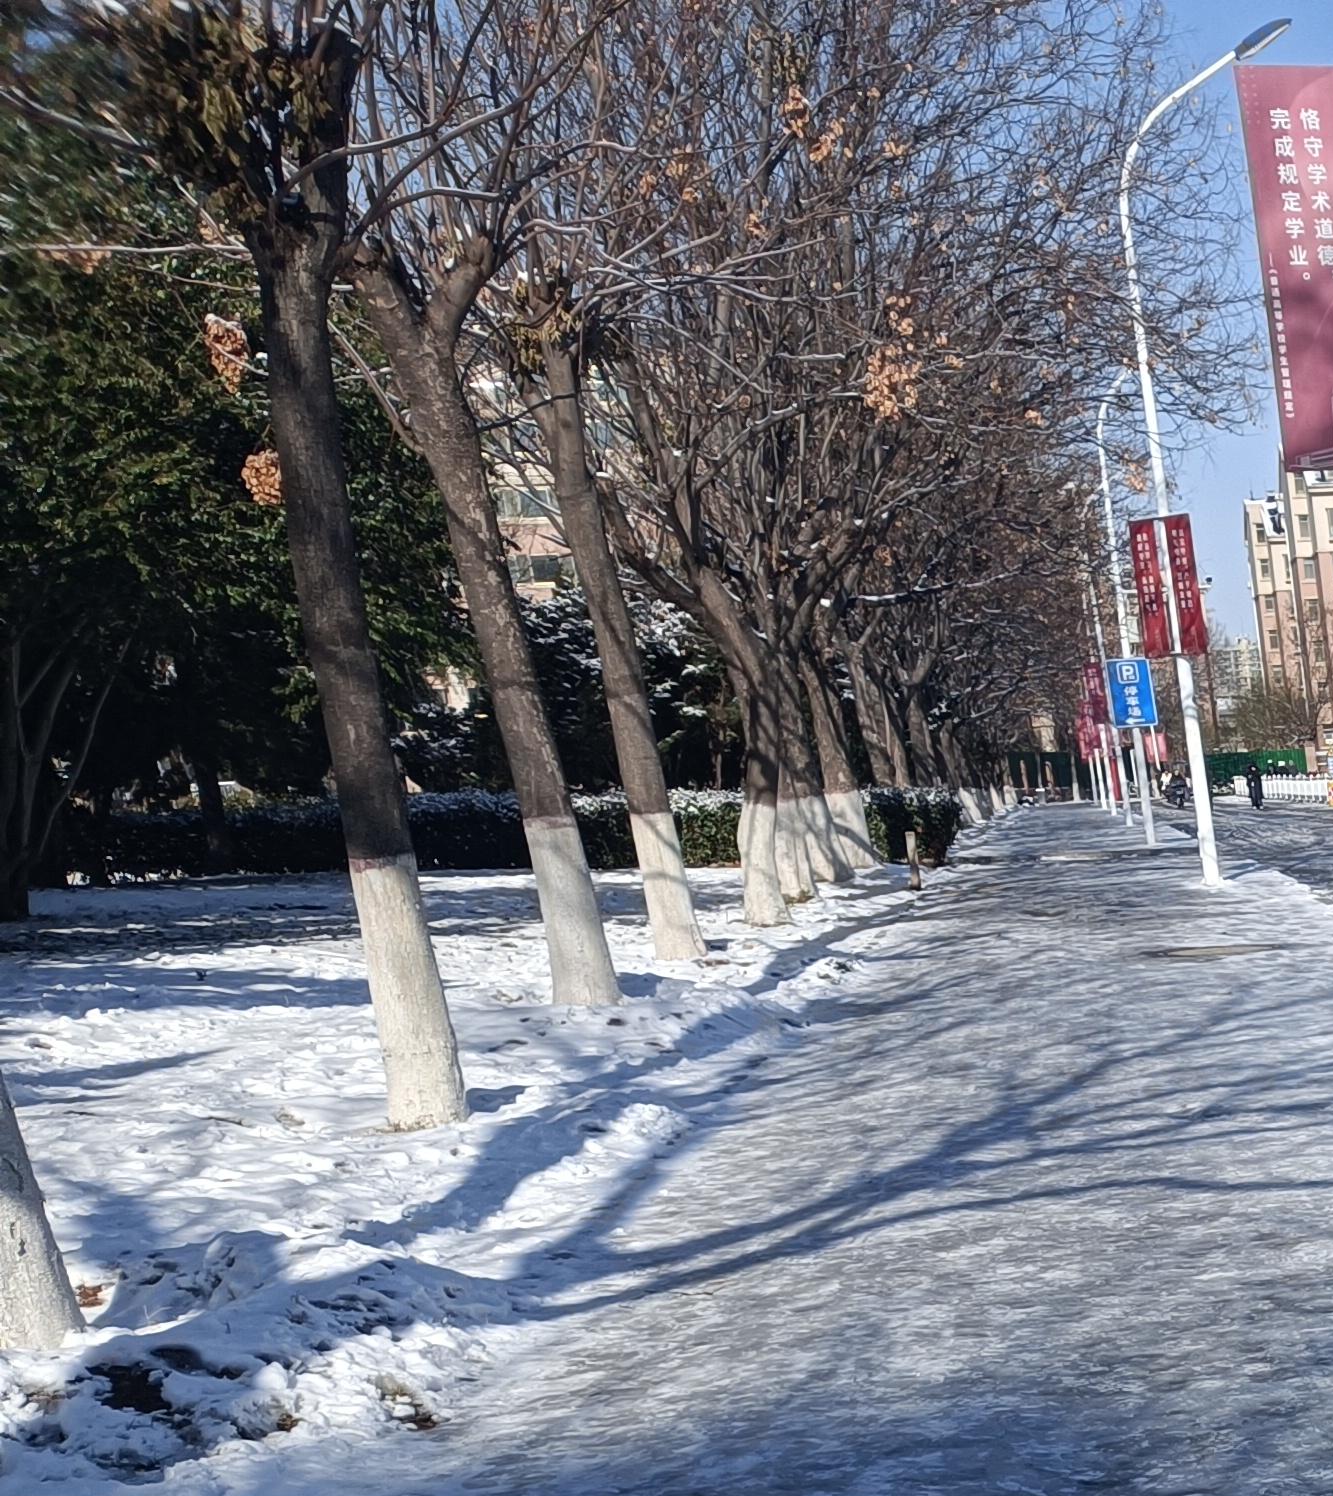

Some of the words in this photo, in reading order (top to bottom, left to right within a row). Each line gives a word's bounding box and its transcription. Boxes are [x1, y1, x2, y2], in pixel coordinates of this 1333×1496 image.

[1269, 108, 1311, 281] 完成规定学业。
[1123, 686, 1142, 716] 停车场
